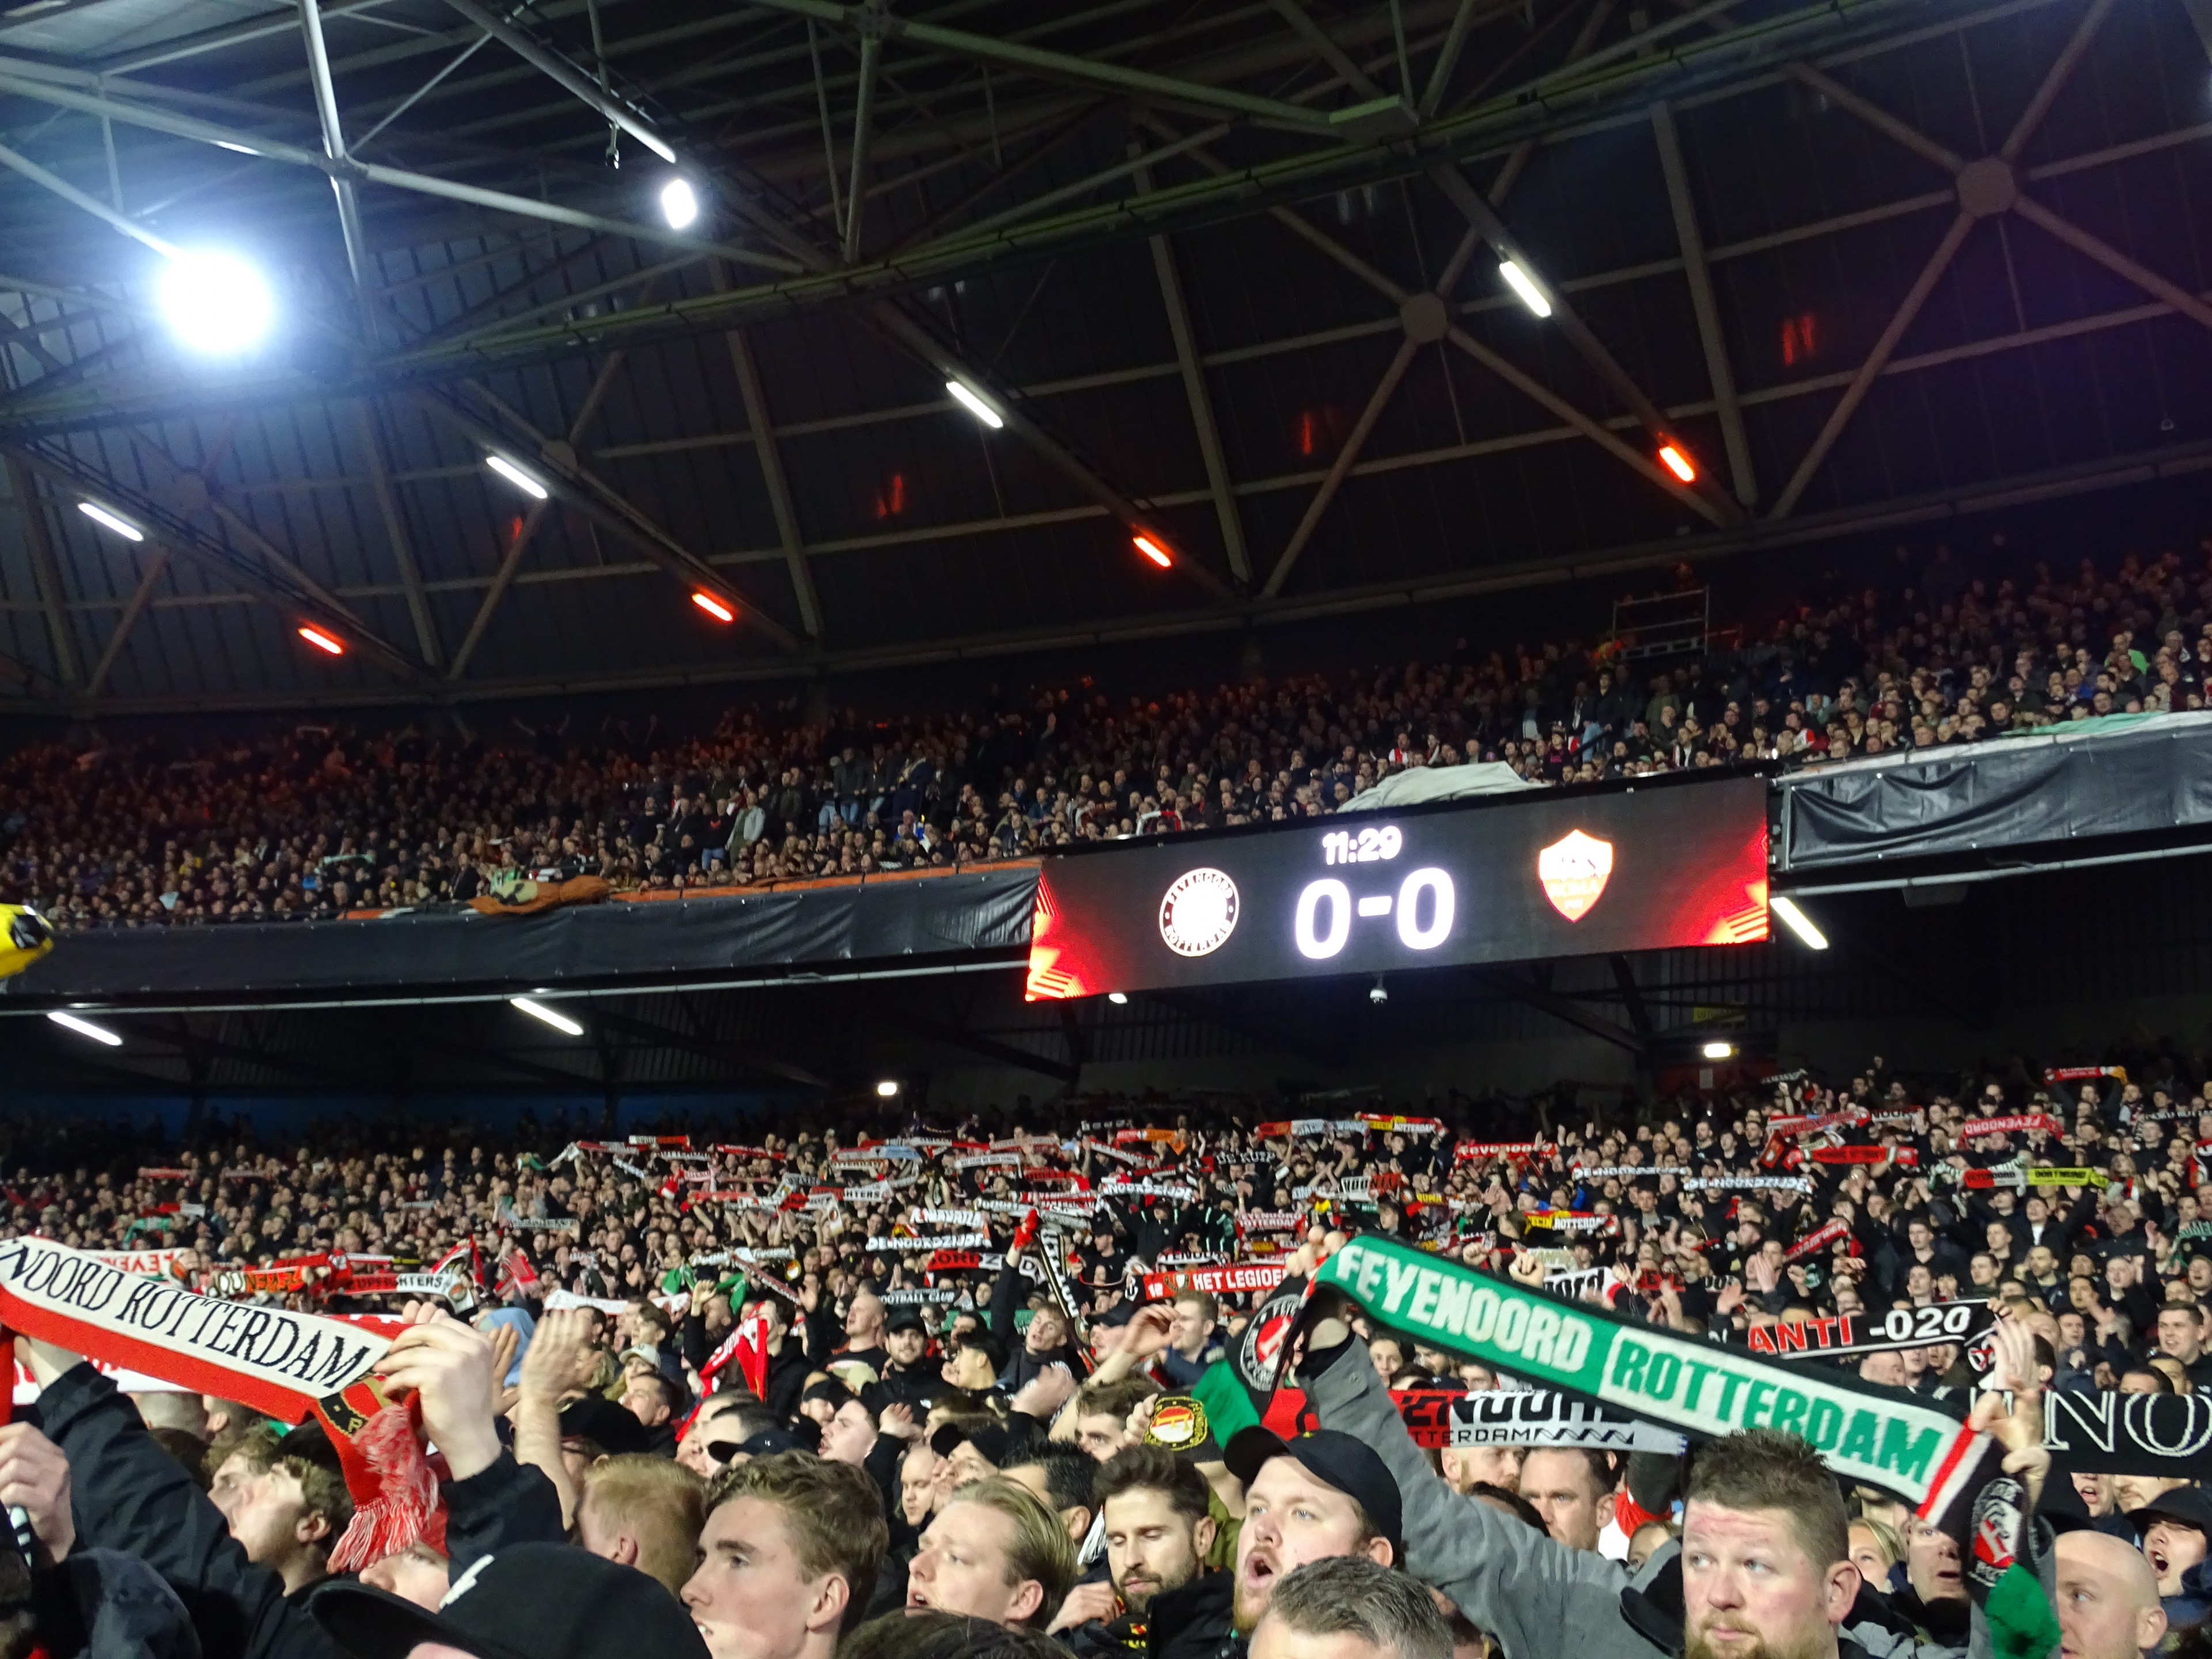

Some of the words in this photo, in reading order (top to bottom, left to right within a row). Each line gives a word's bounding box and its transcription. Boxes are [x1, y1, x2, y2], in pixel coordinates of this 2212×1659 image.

[1323, 826, 1402, 865] 11:29
[1965, 1116, 2041, 1134] FEYENOORD
[1192, 1272, 1222, 1291] HET
[1225, 1268, 1286, 1289] LEGIOE
[0, 1240, 123, 1311] NOORD
[116, 1280, 369, 1388] ROTTERDAM
[878, 1293, 924, 1305] OOTBALL
[1748, 1316, 1853, 1355] ANTI
[1870, 1306, 1971, 1340] -020
[1336, 1245, 1593, 1373] FEYENOORD
[1611, 1338, 1945, 1484] ROTTERDAM
[1414, 1427, 1529, 1444] TTERDAM
